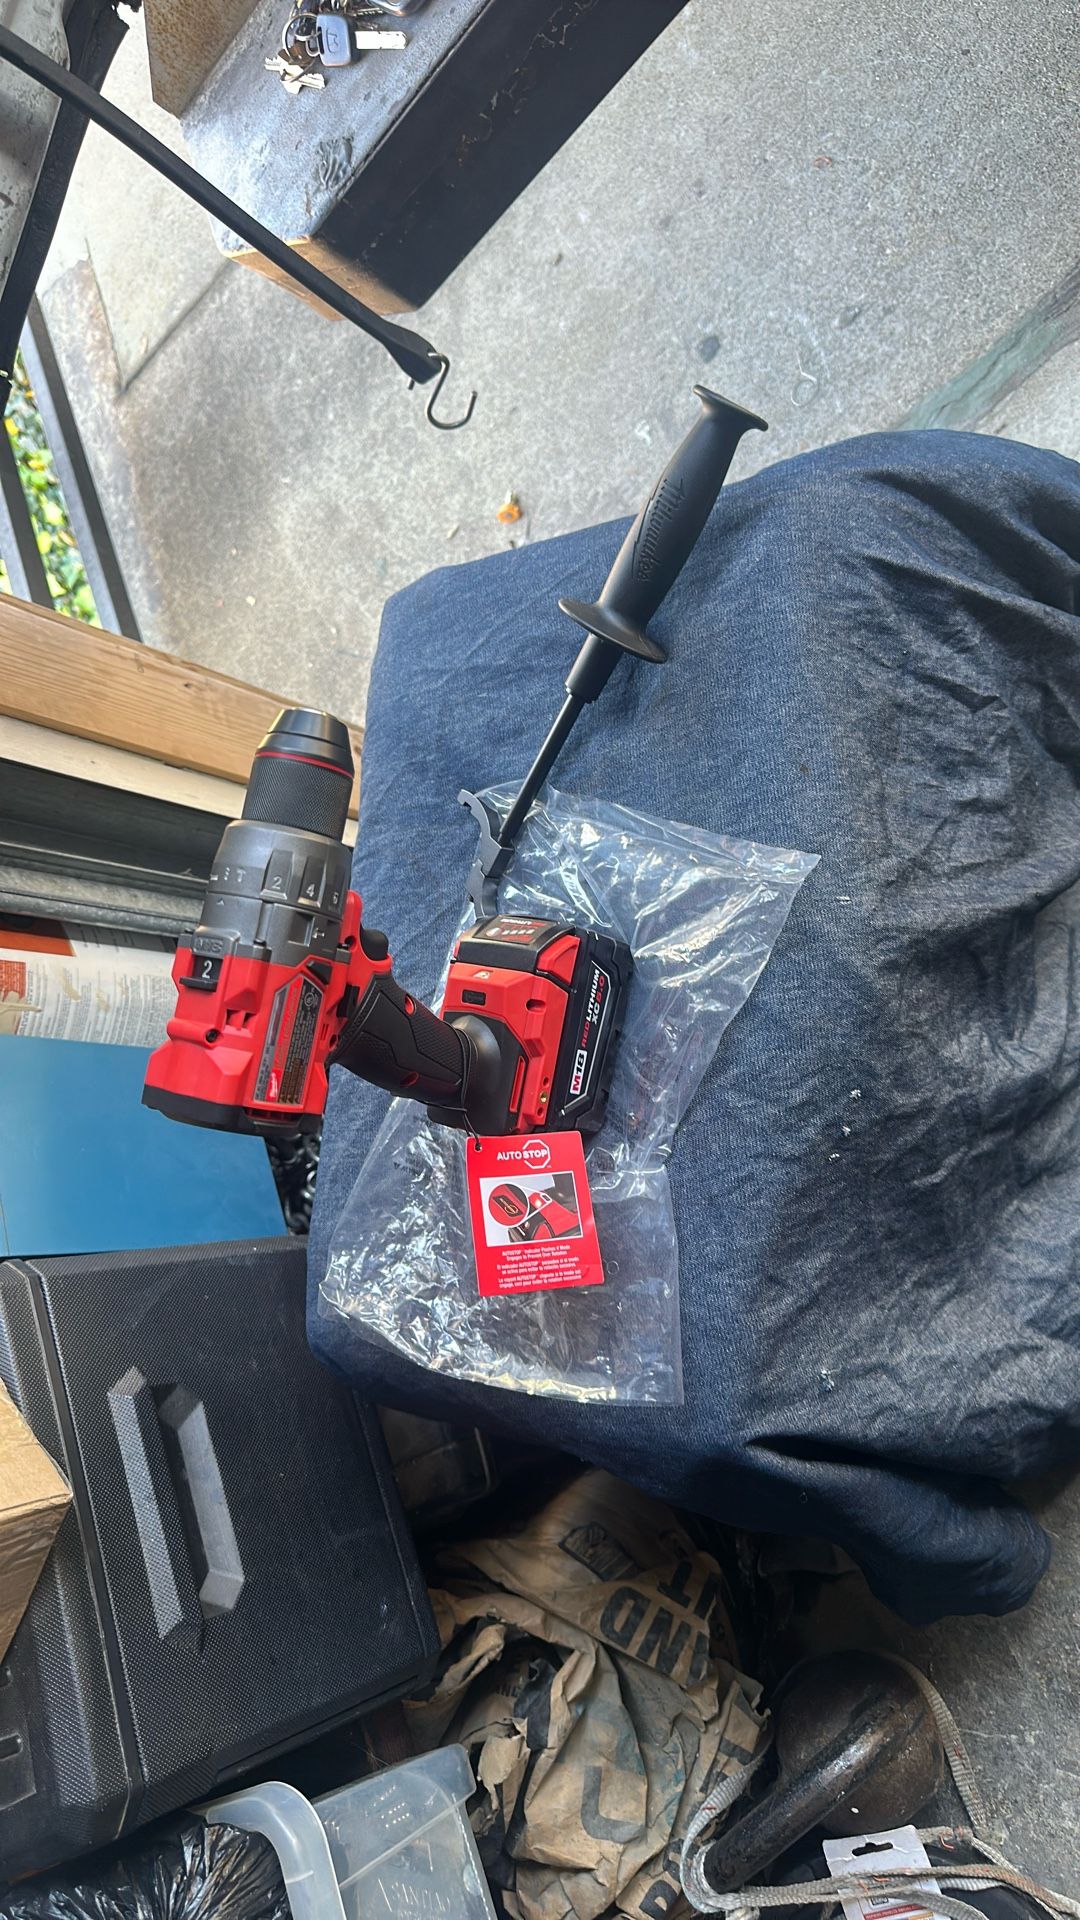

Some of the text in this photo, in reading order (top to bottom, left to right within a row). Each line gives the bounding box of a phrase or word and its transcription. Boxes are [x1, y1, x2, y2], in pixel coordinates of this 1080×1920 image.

[637, 478, 685, 581] Milwaukee
[272, 876, 283, 889] 2
[306, 883, 315, 897] 4
[201, 960, 212, 978] 2
[591, 975, 605, 1025] XC5.0
[572, 968, 600, 1093] M18 REDLITHIUM
